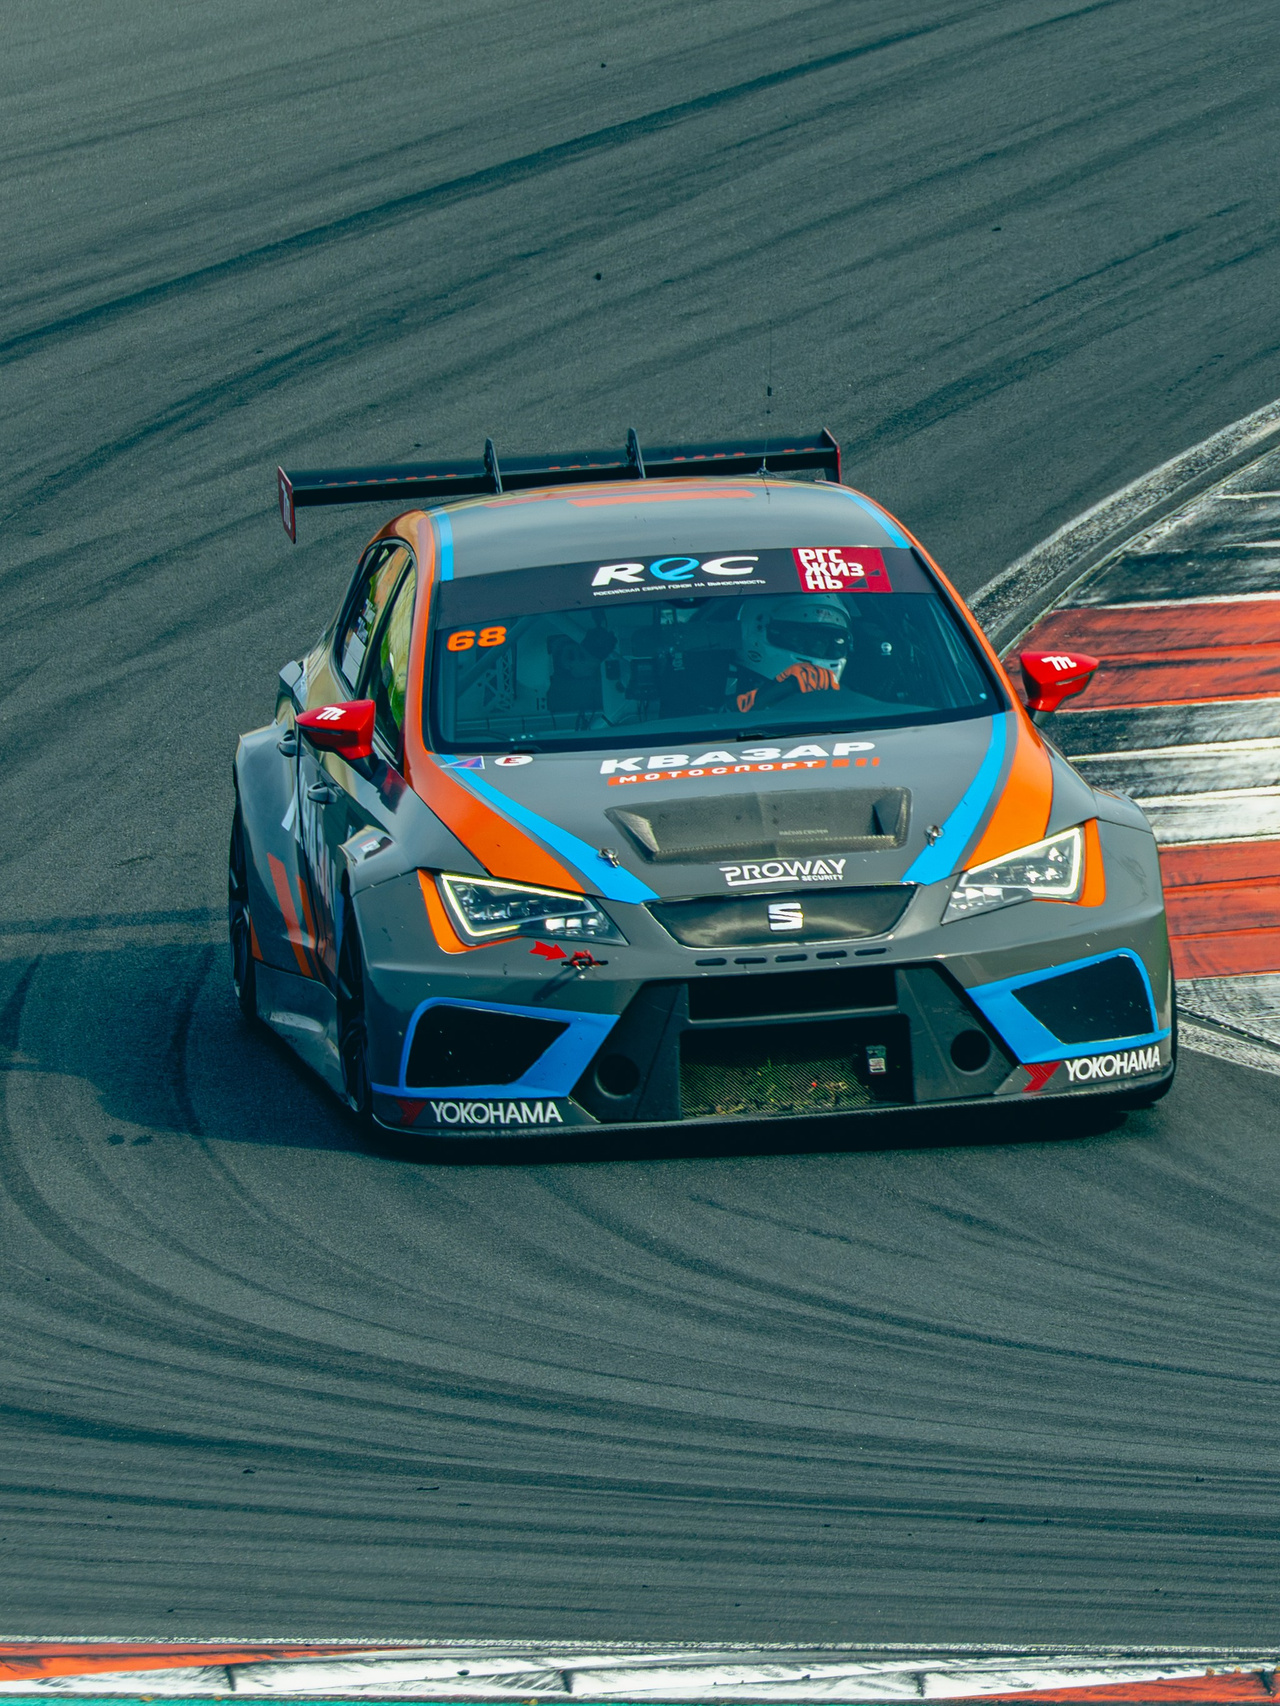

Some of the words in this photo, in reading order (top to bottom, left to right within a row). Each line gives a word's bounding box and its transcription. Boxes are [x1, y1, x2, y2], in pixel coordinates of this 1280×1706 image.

[798, 548, 844, 563] РГС
[802, 562, 865, 576] ЖИЗ
[805, 575, 843, 589] НЬ
[447, 626, 507, 652] 68
[600, 741, 876, 775] КВАЗАР
[618, 760, 819, 784] МОТОСПОРТ
[719, 859, 846, 882] PROWAY
[801, 874, 844, 882] SECURITY
[1064, 1045, 1161, 1081] YOKOHAMA
[430, 1100, 563, 1124] YOKOHAMA
